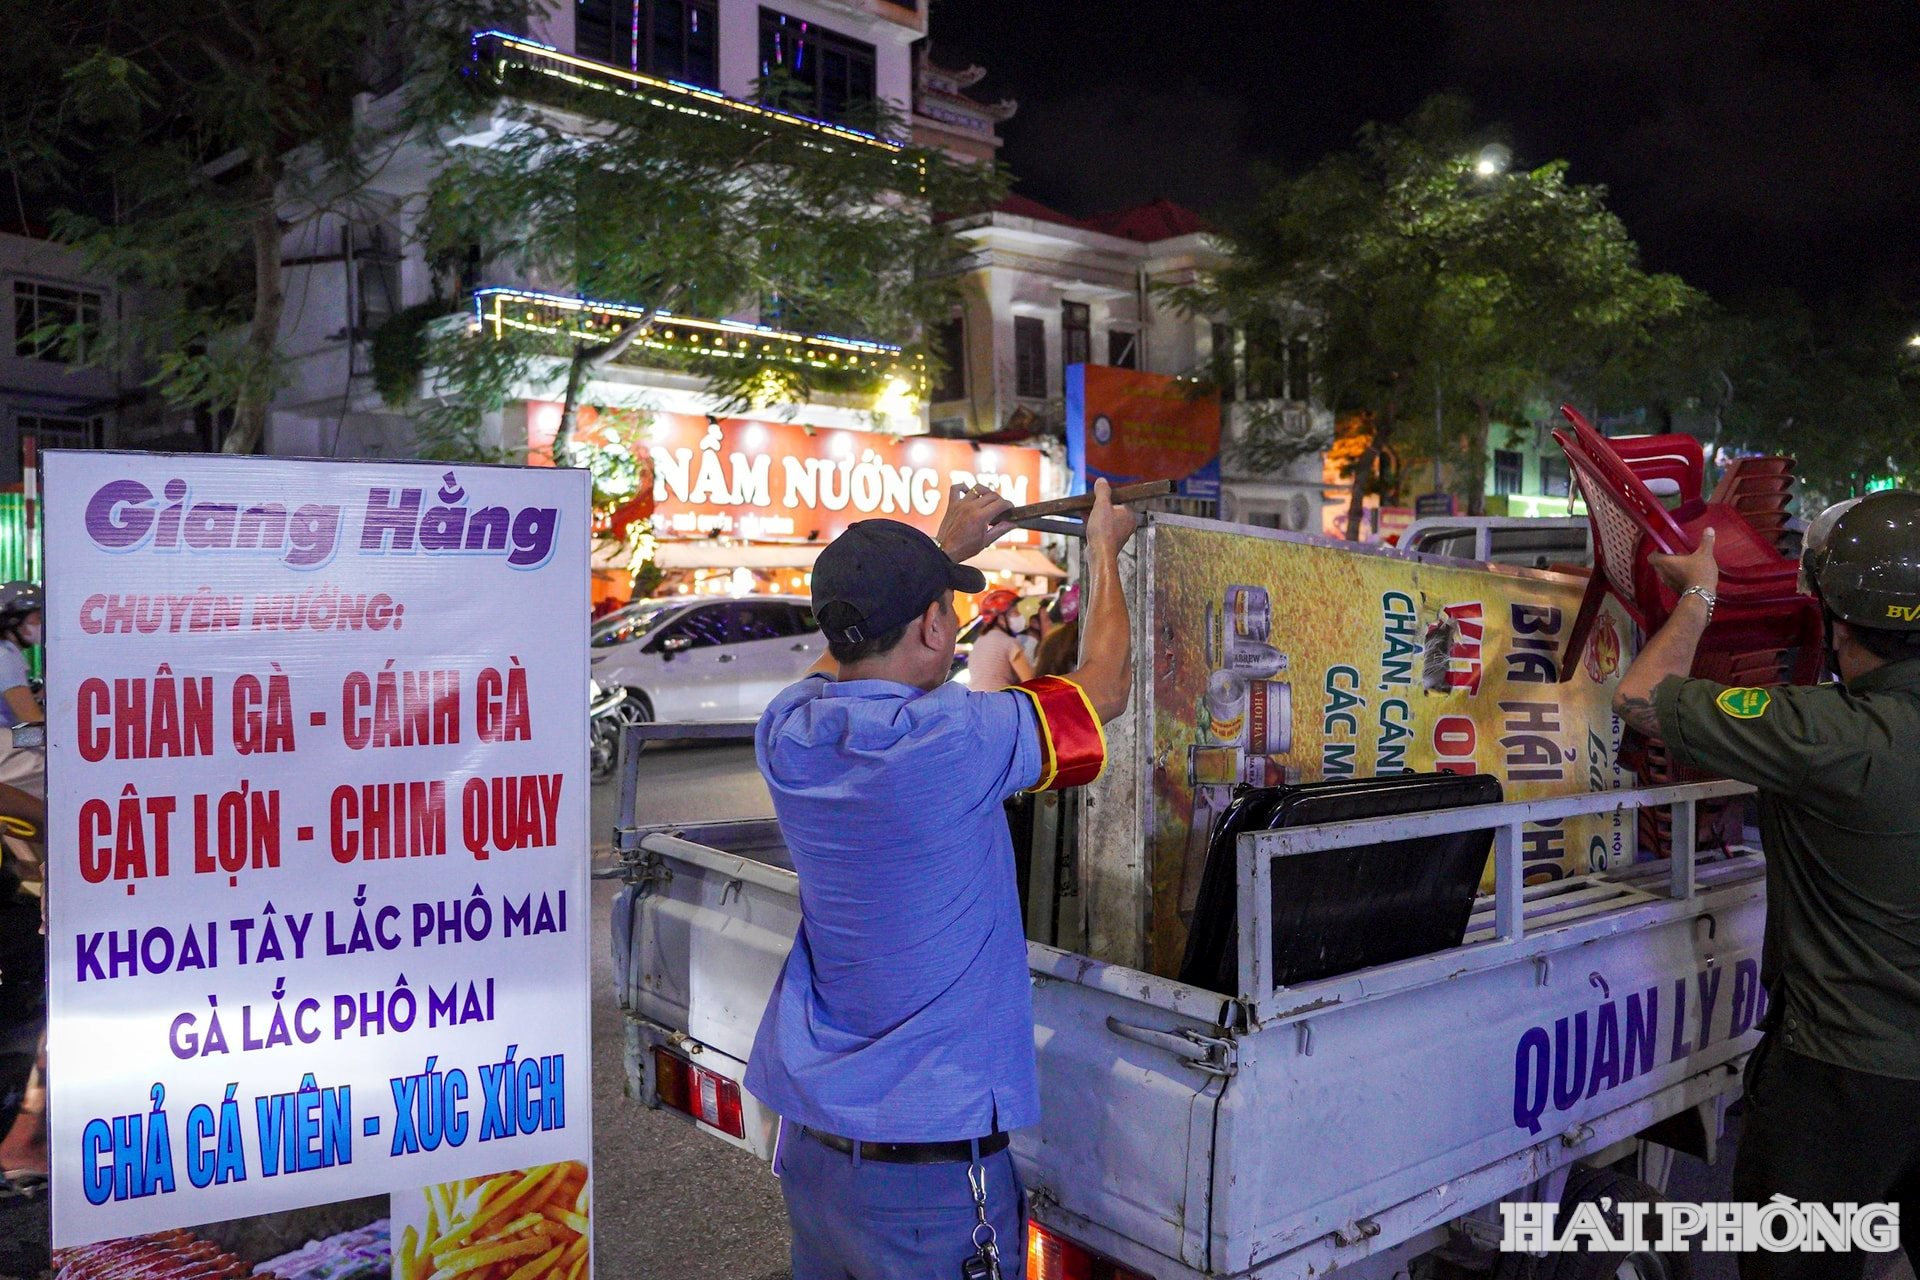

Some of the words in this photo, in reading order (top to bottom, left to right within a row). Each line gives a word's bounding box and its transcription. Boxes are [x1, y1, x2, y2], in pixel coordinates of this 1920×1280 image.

[85, 478, 340, 569] Giang
[359, 471, 561, 569] Hằng
[782, 448, 941, 516] NƯỚNG
[79, 586, 243, 634] CHUYÊN
[252, 581, 404, 632] NƯỚNG:
[1379, 591, 1423, 690] CHÂN,
[1505, 603, 1561, 684] BIA
[77, 662, 213, 762] CHÂN
[232, 662, 295, 755] GÀ
[311, 711, 326, 726] -
[343, 659, 460, 751] CÁNH
[476, 656, 531, 742] GÀ
[1324, 666, 1366, 735] CÁC
[1498, 703, 1576, 781] HẢI
[1323, 744, 1355, 783] M
[1433, 717, 1477, 776] O
[78, 783, 176, 895] CẬT
[194, 780, 280, 887] LỢN
[298, 826, 313, 841] -
[330, 780, 447, 864] CHIM
[462, 774, 563, 860] QUAY
[76, 922, 217, 982] KHOAI
[230, 901, 312, 964] TÂY
[325, 884, 402, 956] LẮC
[412, 883, 492, 947] PHÔ
[503, 890, 567, 938] MAI
[168, 995, 230, 1060] GÀ
[242, 976, 321, 1051] LẮC
[334, 973, 417, 1040] PHÔ
[429, 977, 494, 1028] MAI
[1513, 971, 1658, 1136] QUẢN
[81, 1081, 175, 1206] CHẢ
[186, 1081, 247, 1189] CÁ
[255, 1072, 352, 1177] VIÊN
[363, 1115, 380, 1137] -
[390, 1056, 468, 1157] XÚC
[478, 1044, 566, 1143] XÍCH
